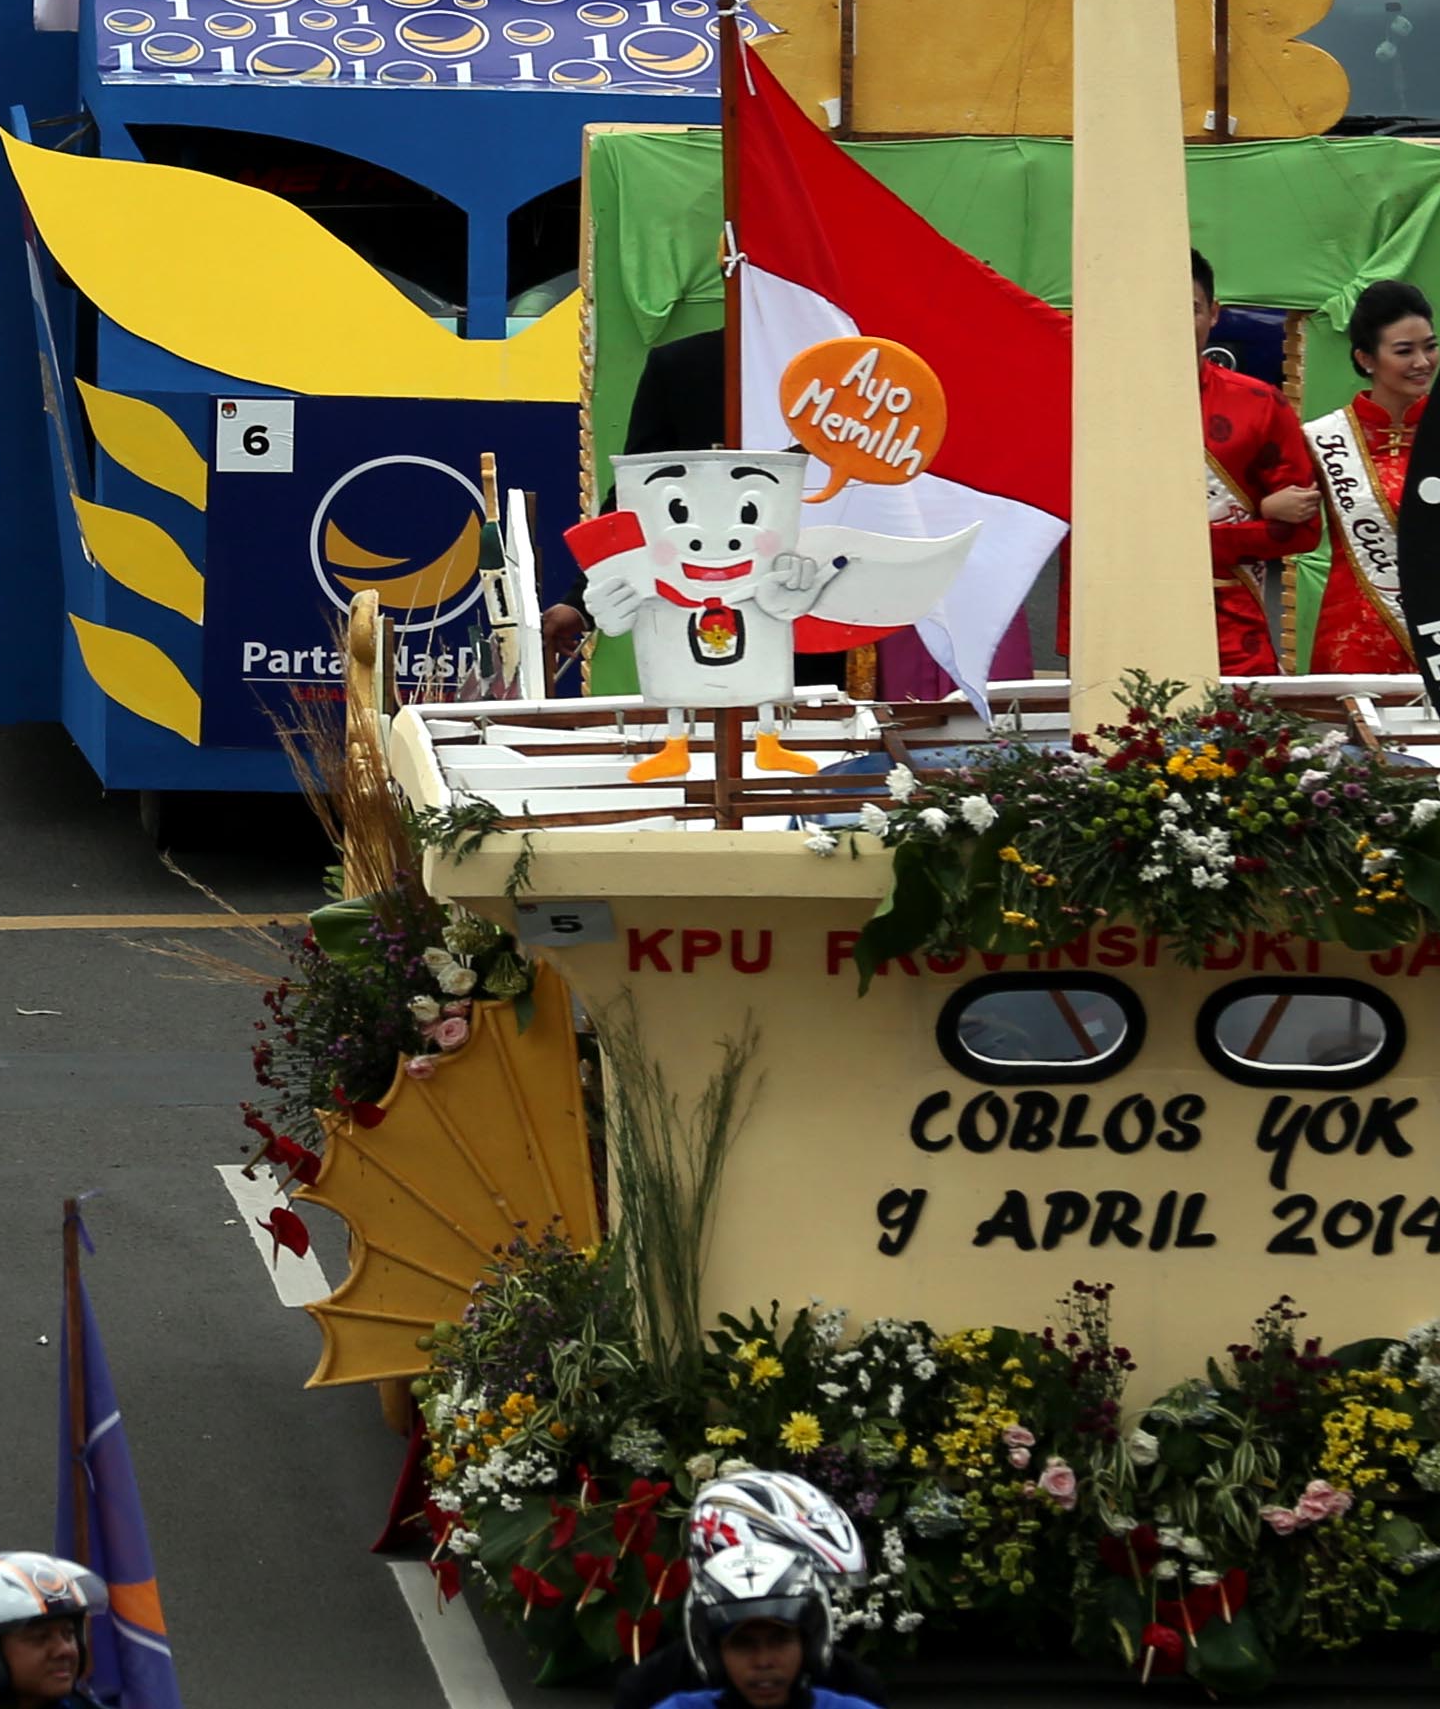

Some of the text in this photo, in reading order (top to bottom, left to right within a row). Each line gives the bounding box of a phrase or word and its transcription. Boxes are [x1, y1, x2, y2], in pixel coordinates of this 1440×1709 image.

[839, 347, 913, 421] Ayo
[241, 424, 271, 457] 6
[788, 378, 923, 477] Memilih
[1316, 433, 1398, 575] Koko Cici
[241, 641, 348, 674] Parta
[550, 914, 585, 934] 5
[626, 926, 774, 975] KPU
[909, 1089, 1420, 1191] COBLOS YOK
[972, 1188, 1218, 1252] APRIL
